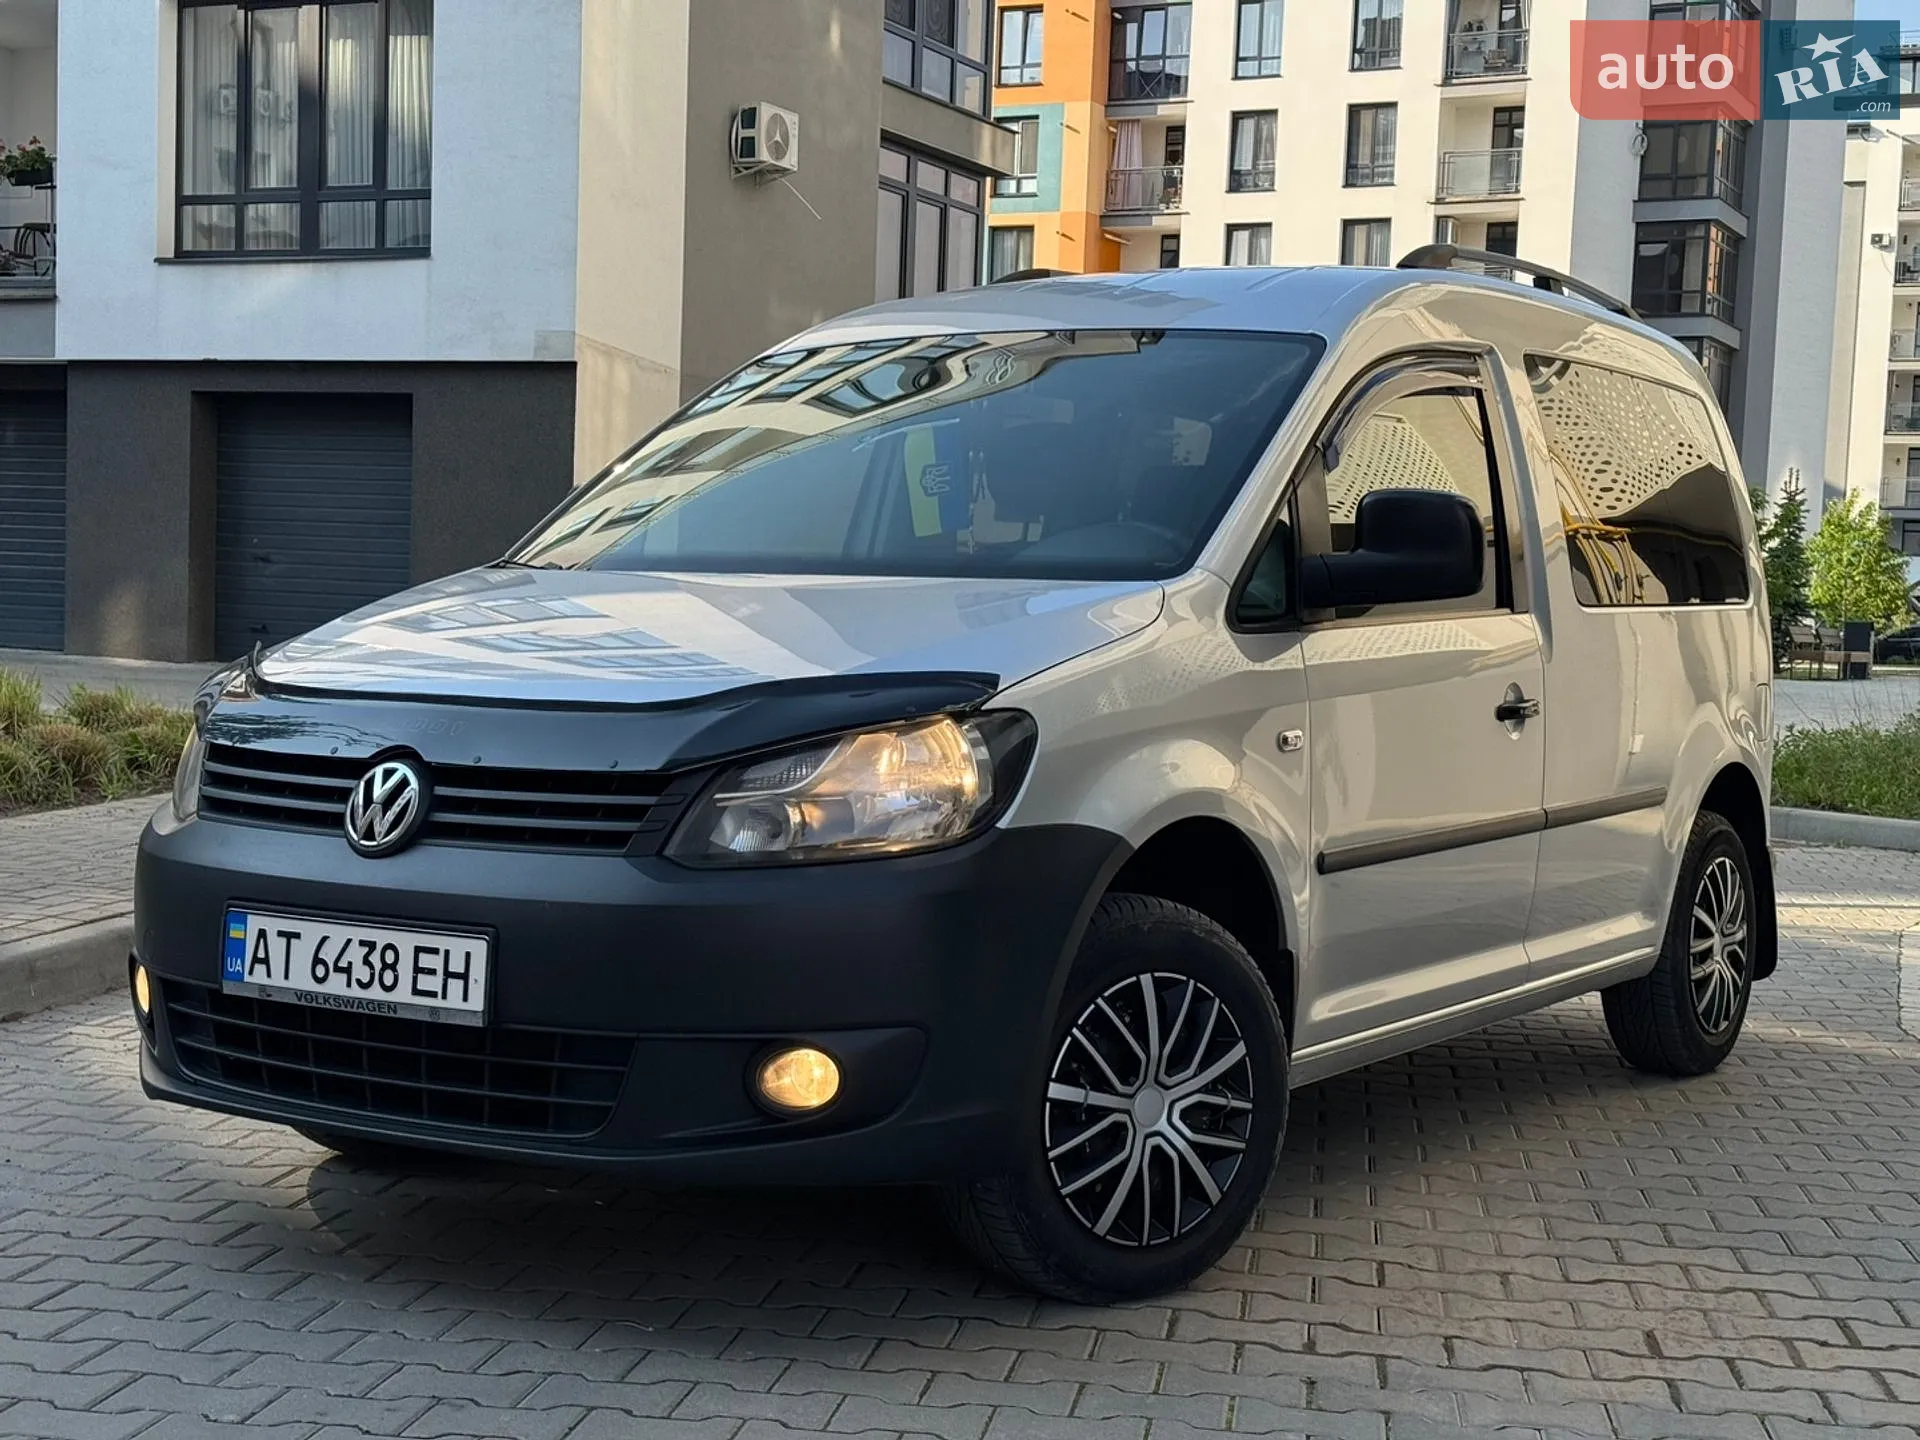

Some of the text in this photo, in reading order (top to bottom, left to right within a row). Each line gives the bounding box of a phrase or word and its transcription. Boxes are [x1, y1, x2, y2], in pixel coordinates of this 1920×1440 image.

[227, 956, 243, 972] UA
[248, 928, 472, 1003] AT 6438 EH
[294, 991, 398, 1016] VOLKSWAGEN
